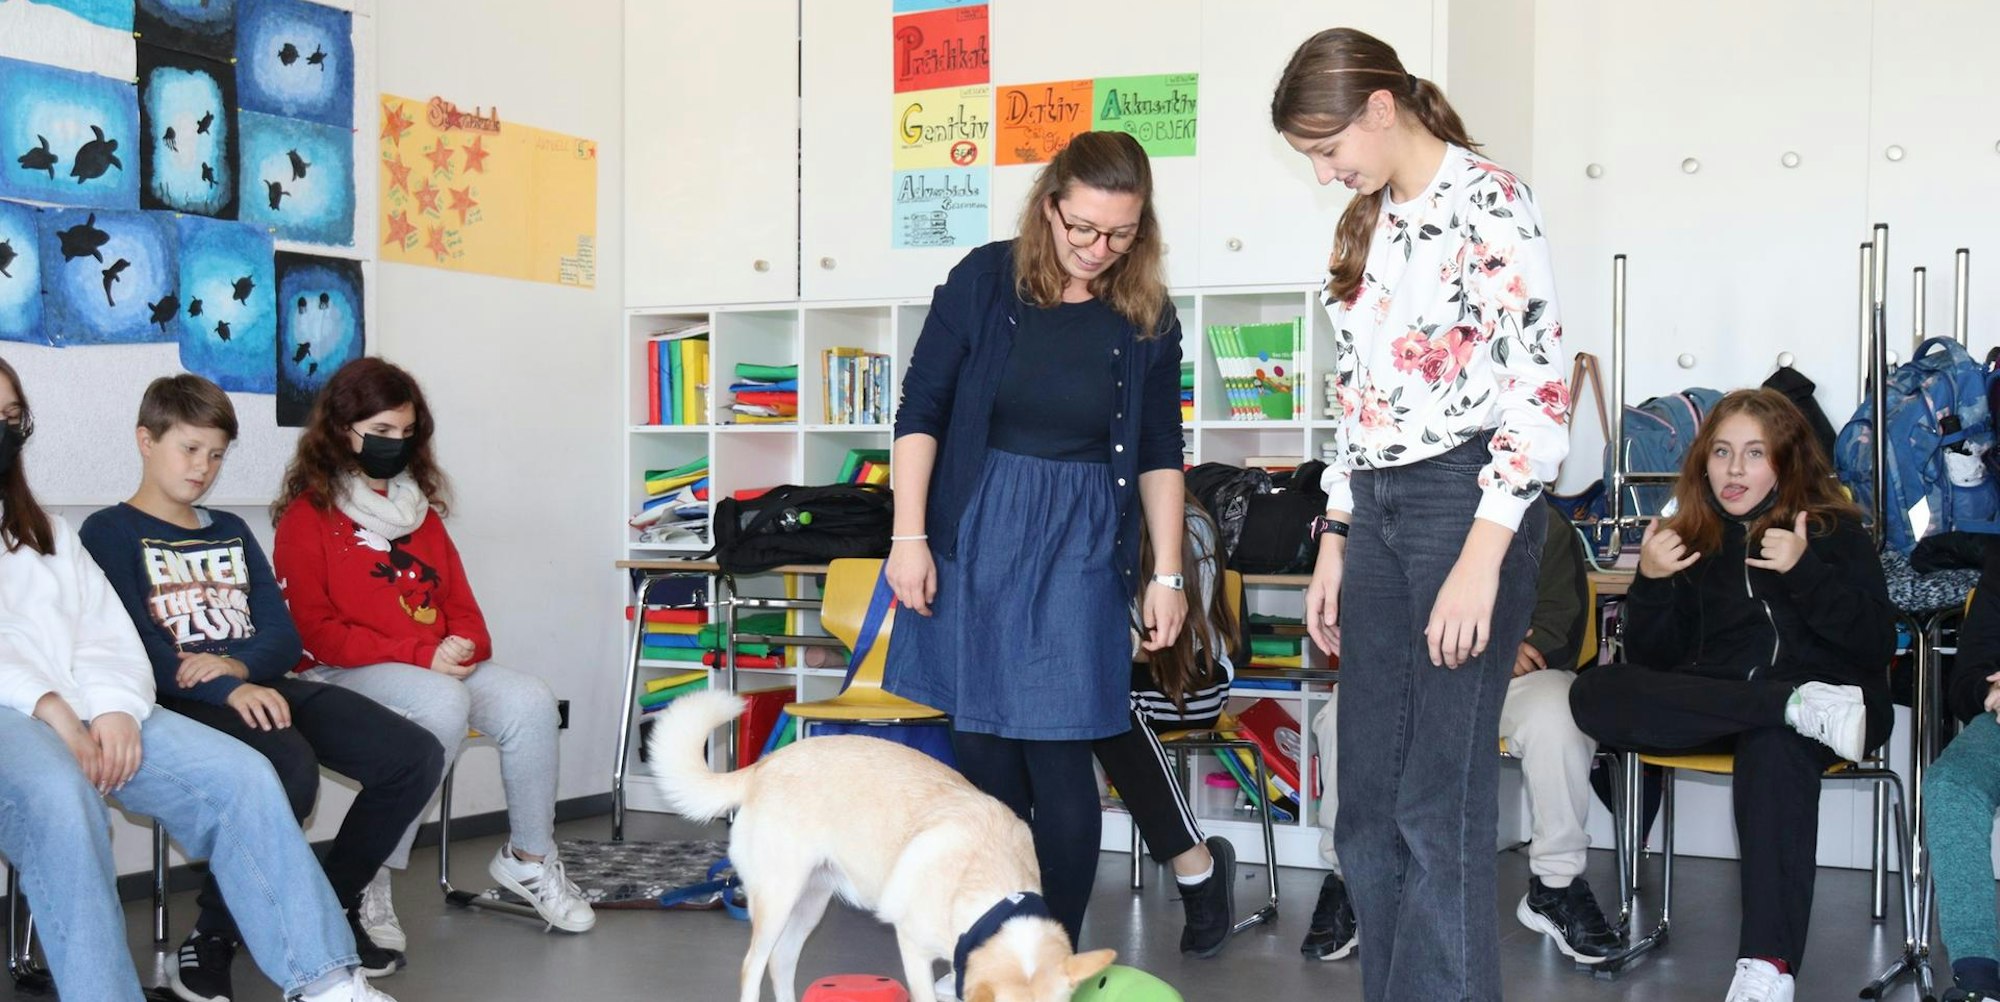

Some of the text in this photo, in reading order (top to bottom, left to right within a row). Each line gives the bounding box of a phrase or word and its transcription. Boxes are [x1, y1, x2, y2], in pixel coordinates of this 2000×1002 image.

[1004, 87, 1080, 125] Dativ
[1101, 89, 1197, 120] Akkusativ
[900, 103, 989, 144] Genitiv
[150, 587, 207, 620] THE
